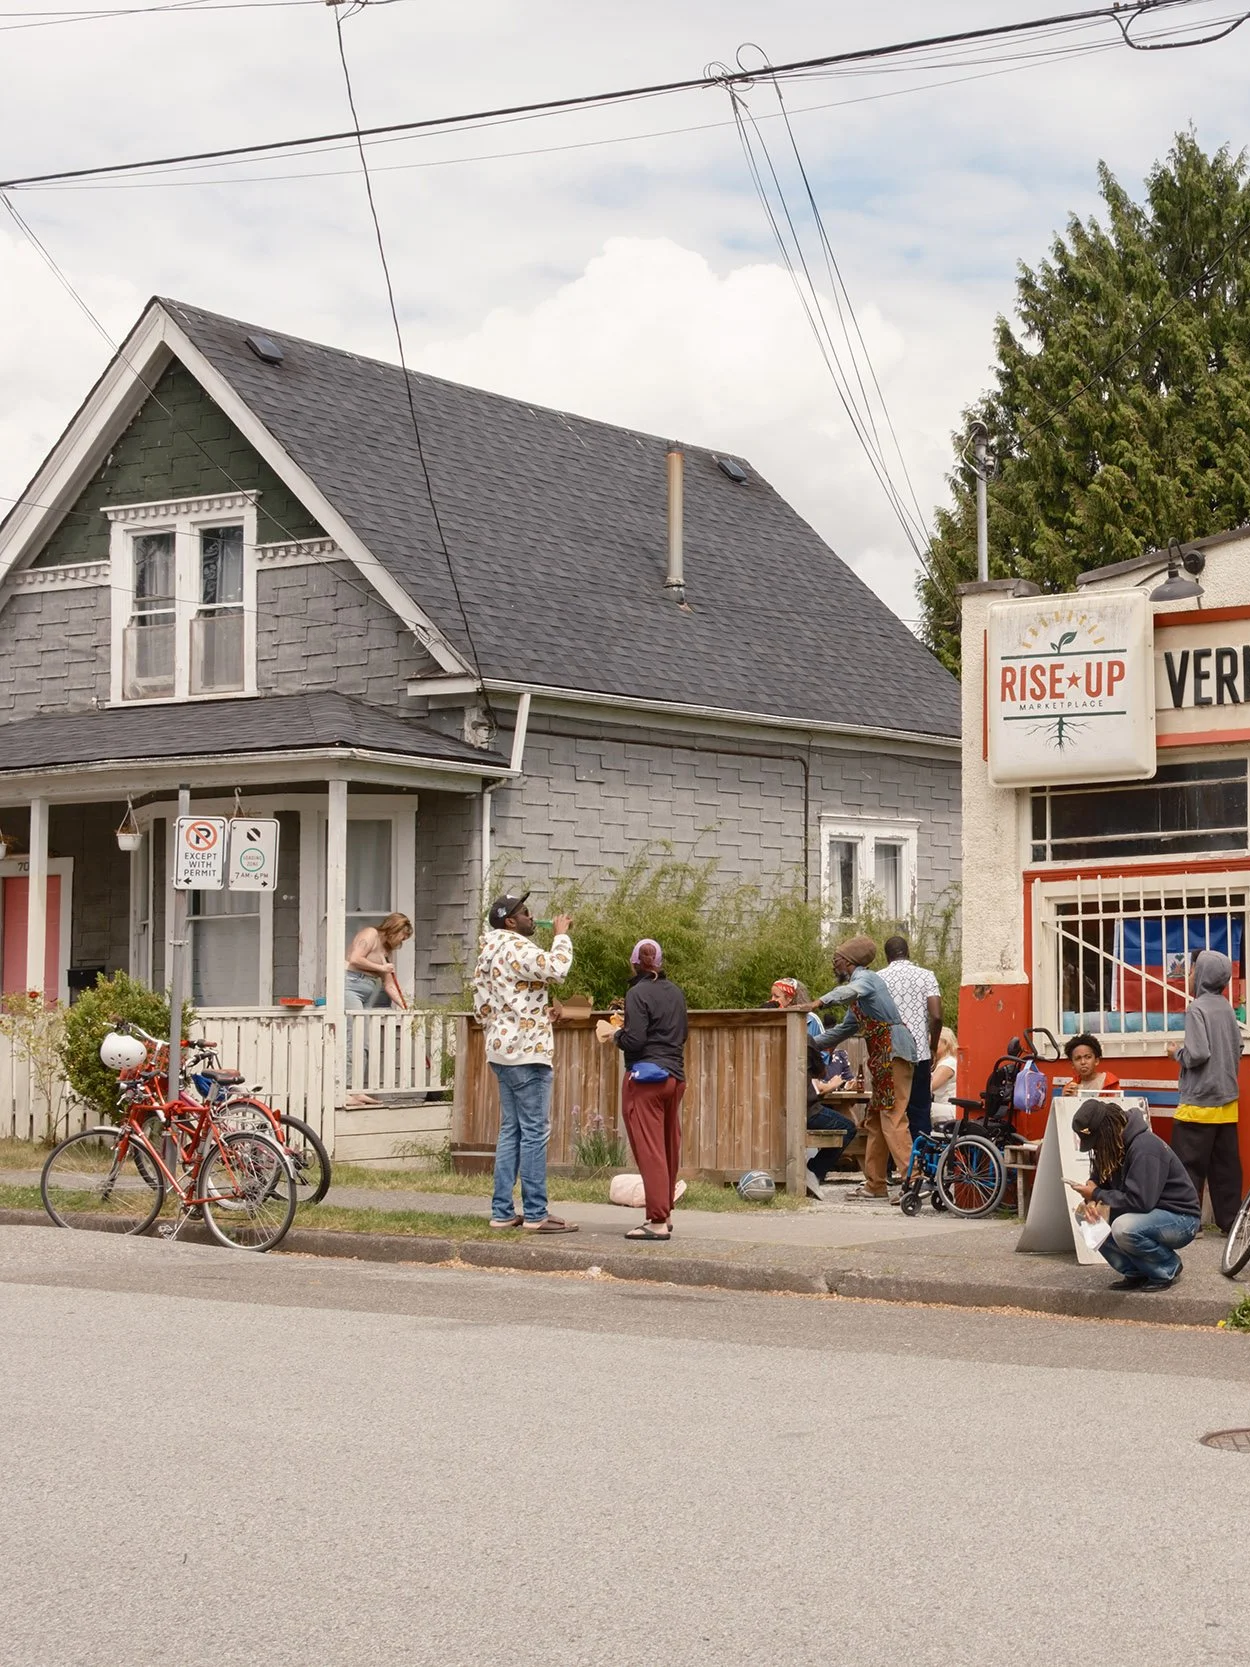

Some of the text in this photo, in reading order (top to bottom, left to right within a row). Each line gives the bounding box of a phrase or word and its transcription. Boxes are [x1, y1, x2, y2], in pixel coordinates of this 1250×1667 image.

[1000, 660, 1126, 702] RISE UP
[1019, 700, 1103, 711] MARKETPLACE
[184, 852, 217, 860] EXCEPT
[184, 869, 217, 877] PERMIT
